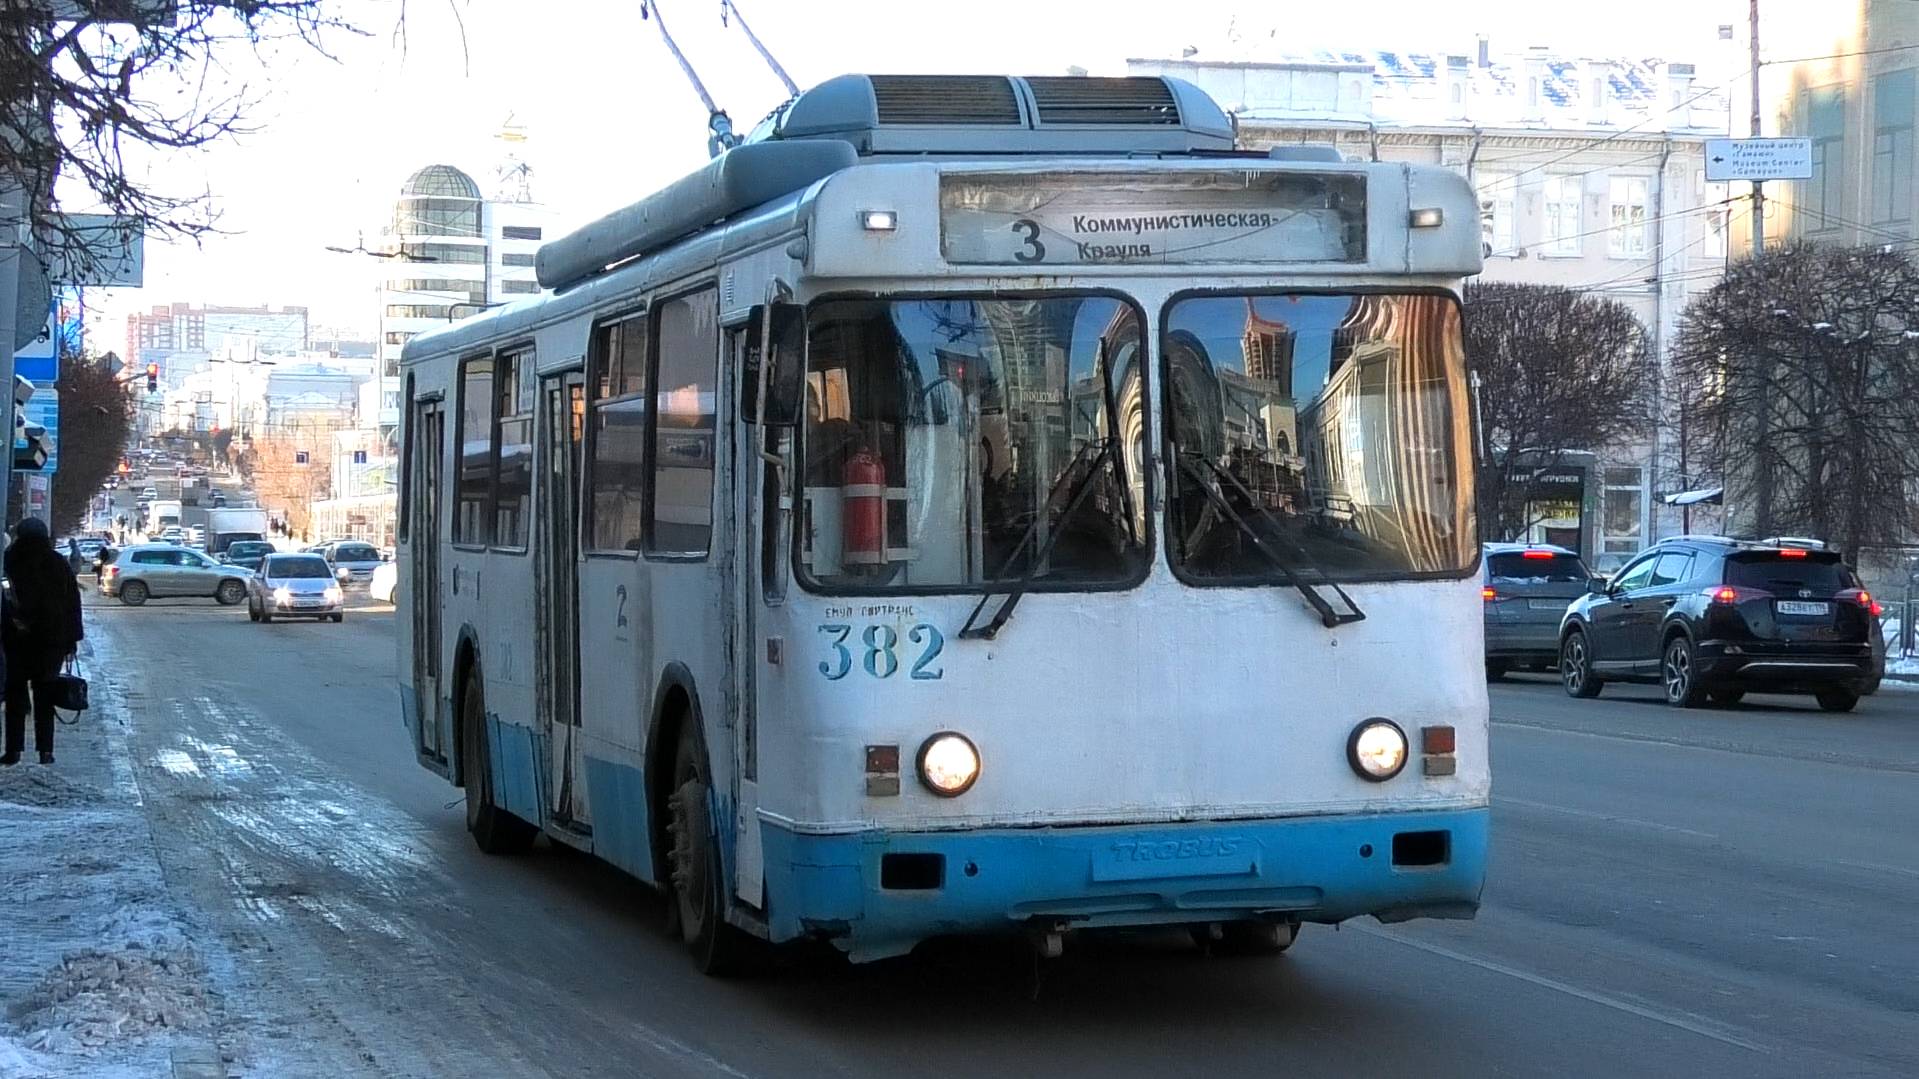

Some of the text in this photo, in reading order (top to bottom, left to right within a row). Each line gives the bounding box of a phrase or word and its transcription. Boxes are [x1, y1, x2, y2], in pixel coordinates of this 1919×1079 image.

[1772, 159, 1804, 167] Center
[1011, 213, 1280, 263] 3 Коммунистическая-
[1077, 242, 1151, 260] Крауля
[818, 623, 944, 680] 382
